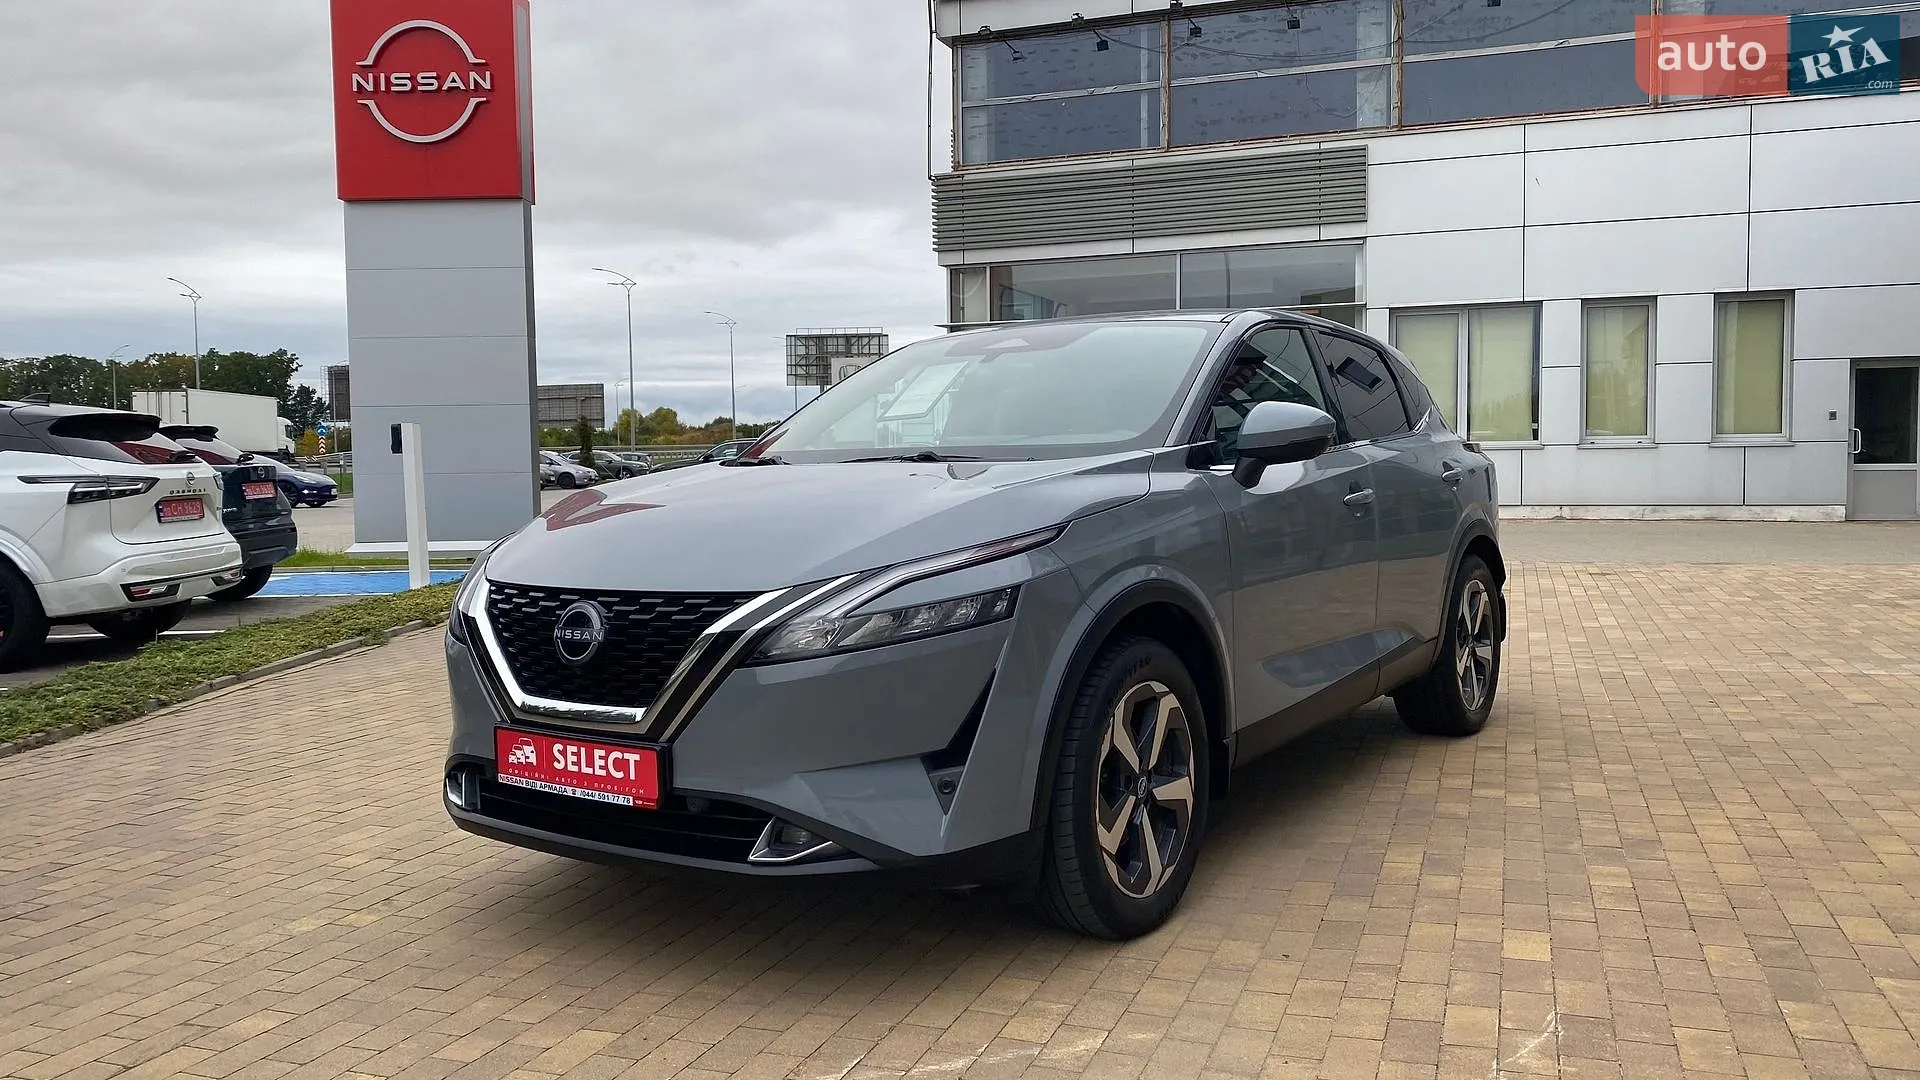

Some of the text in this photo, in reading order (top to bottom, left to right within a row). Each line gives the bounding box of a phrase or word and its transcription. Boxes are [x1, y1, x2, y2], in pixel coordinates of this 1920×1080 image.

[352, 71, 491, 92] NISSAN
[554, 627, 603, 641] NISSAN
[552, 743, 640, 780] SELECT
[499, 774, 524, 786] NISSAN
[539, 782, 568, 794] АРМАДА
